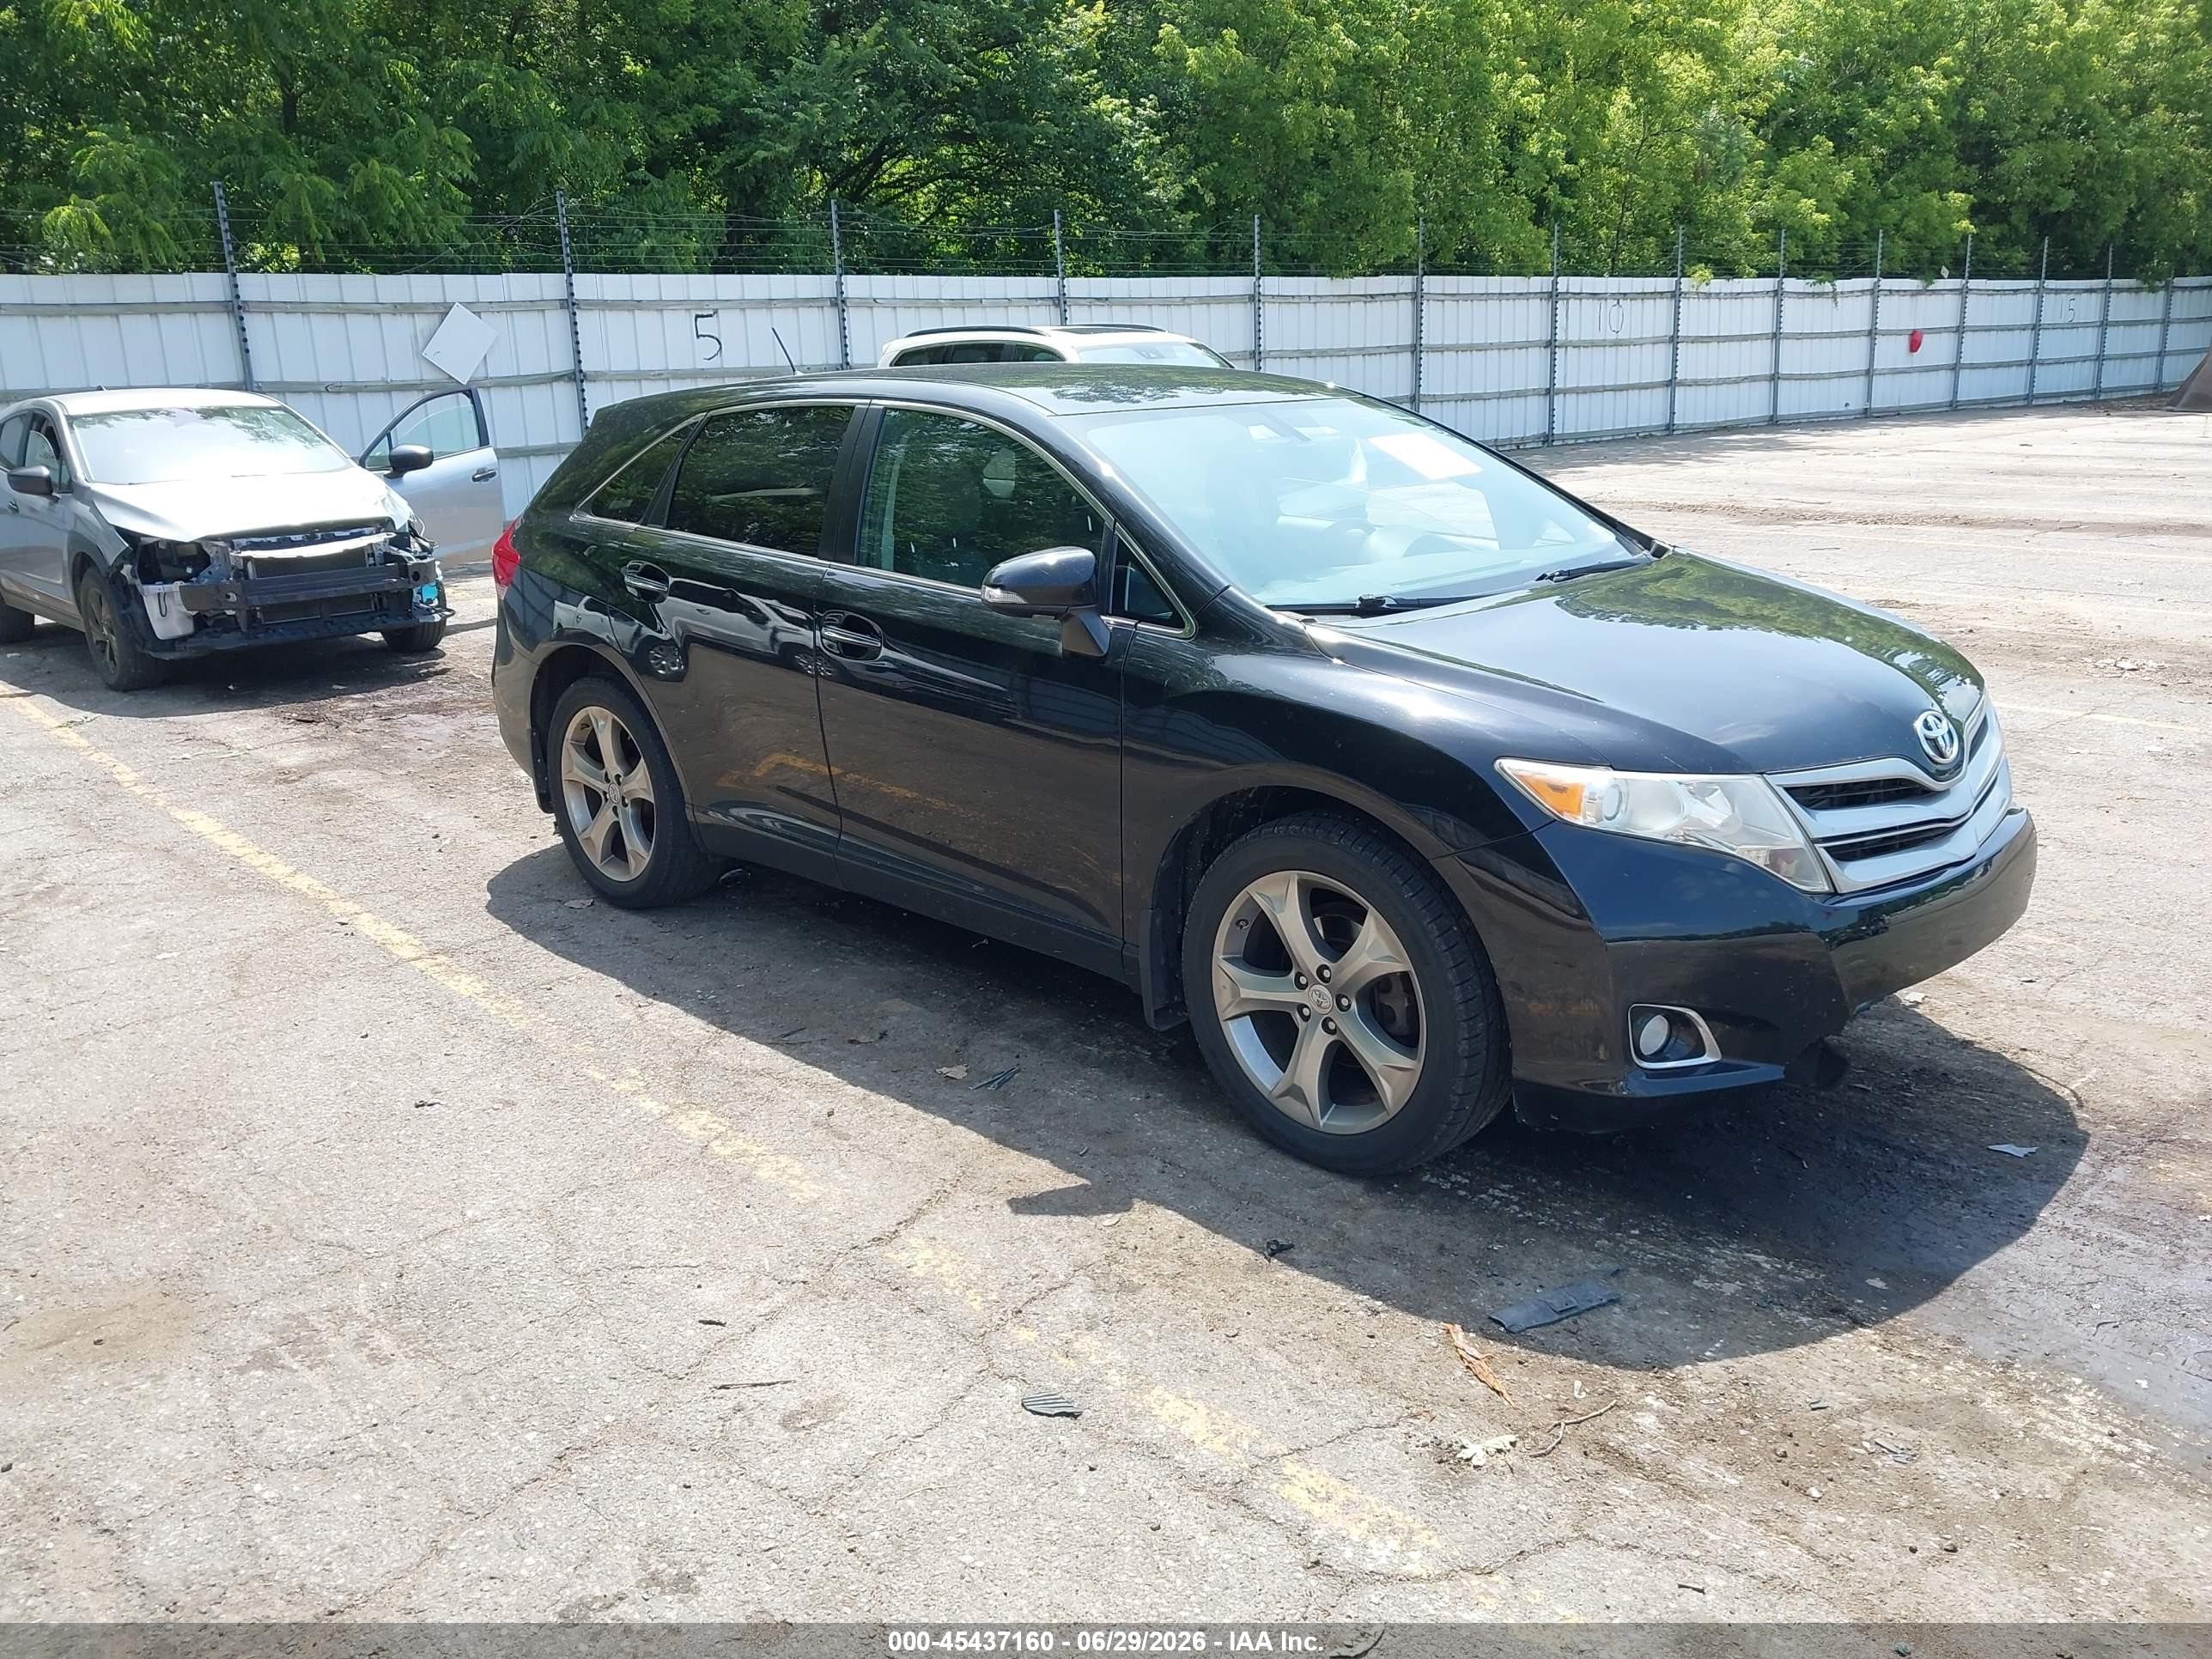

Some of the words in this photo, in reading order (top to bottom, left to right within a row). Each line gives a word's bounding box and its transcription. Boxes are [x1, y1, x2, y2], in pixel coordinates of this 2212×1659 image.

[1598, 301, 1625, 334] 10
[2060, 298, 2075, 323] 15
[695, 311, 722, 361] 5
